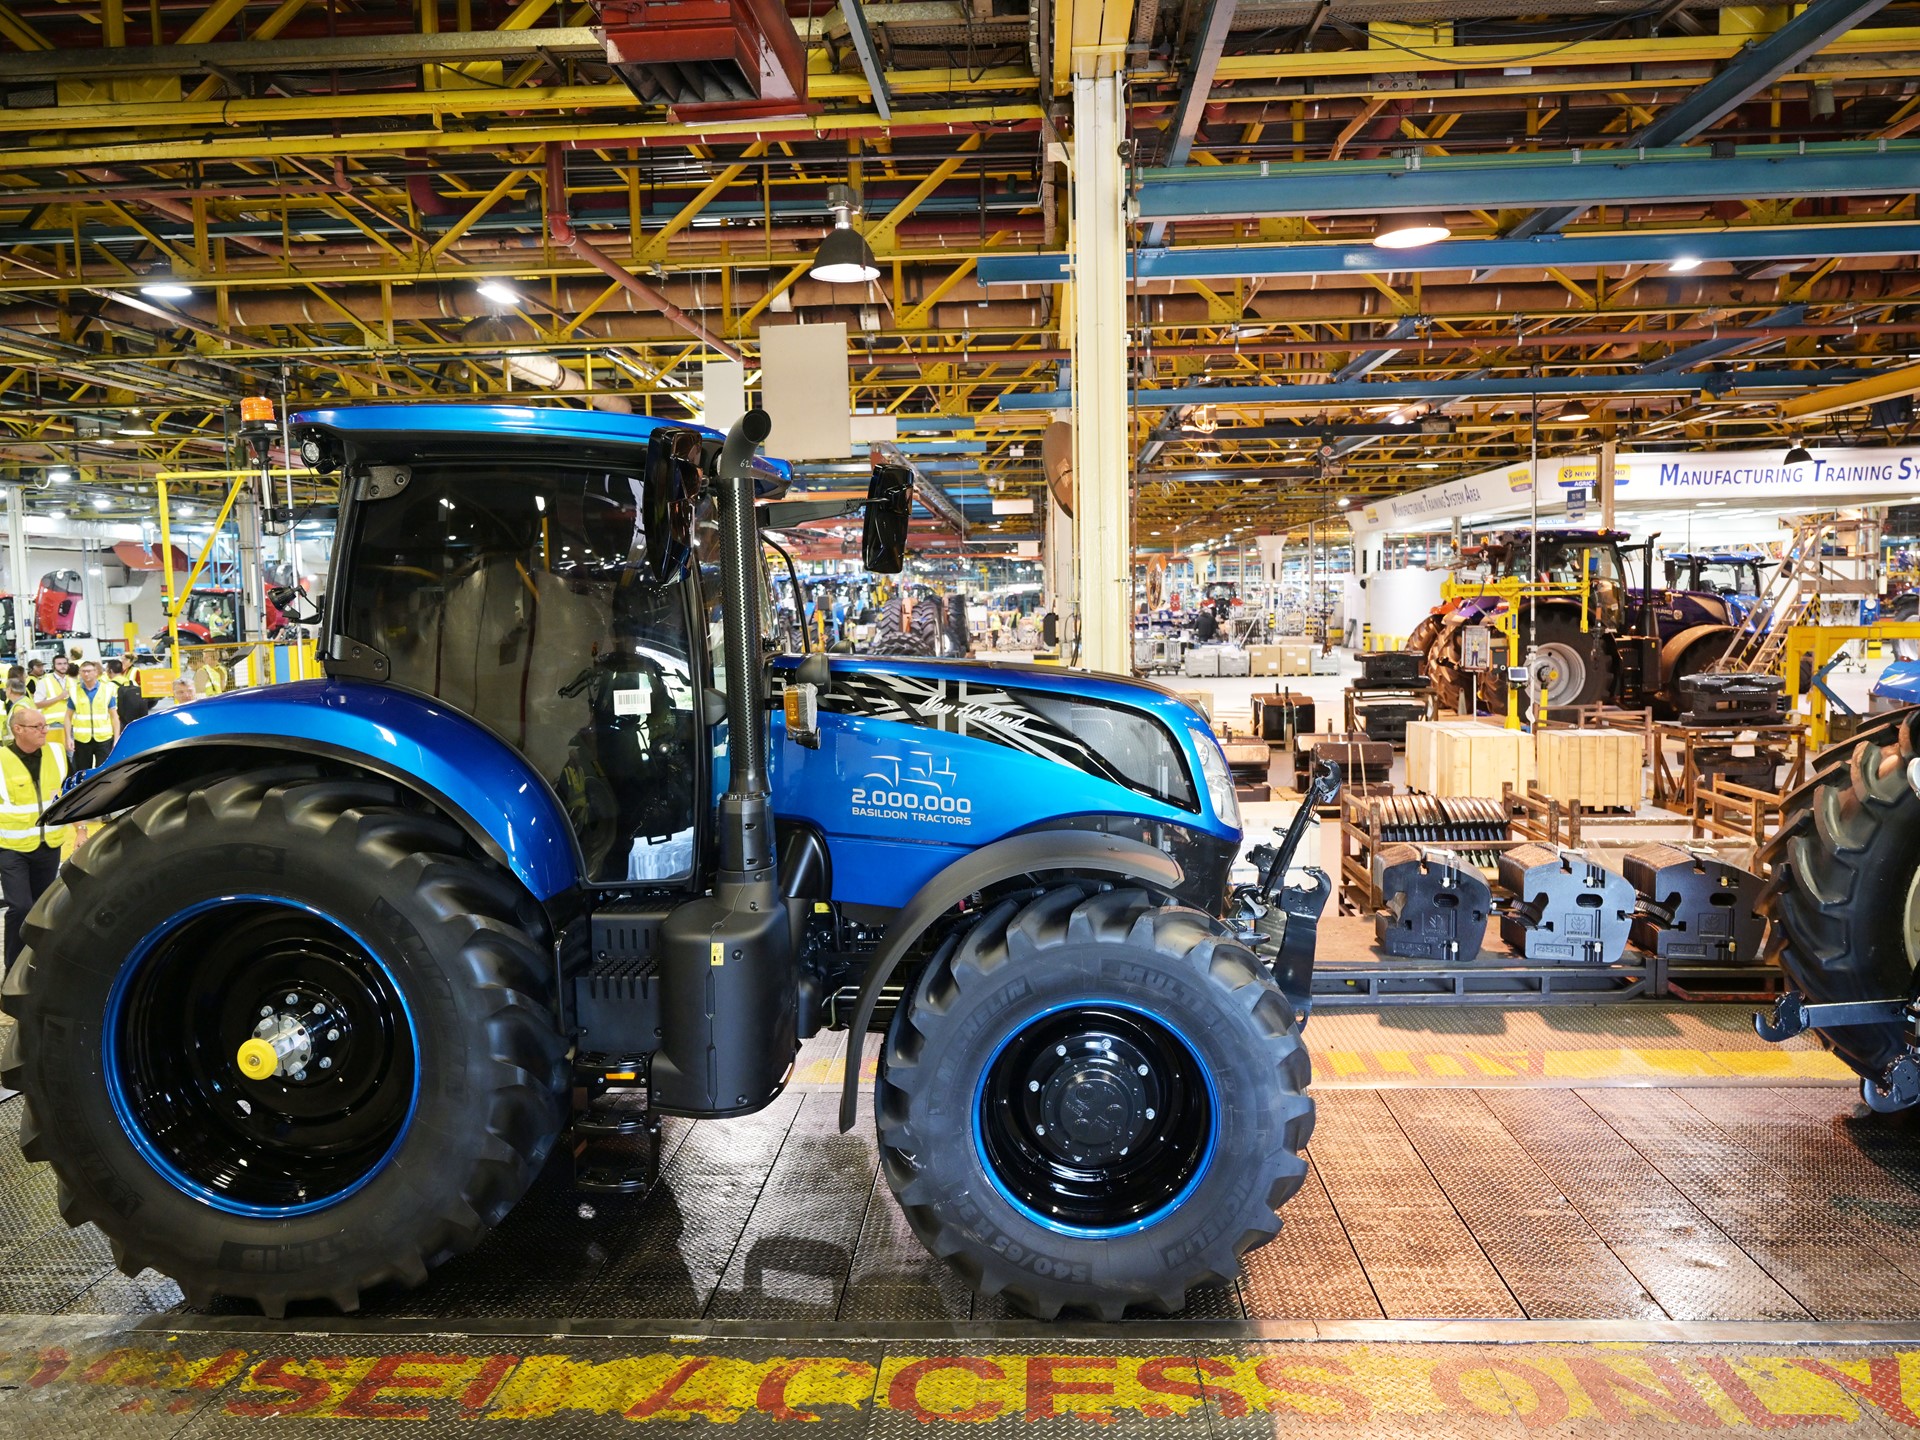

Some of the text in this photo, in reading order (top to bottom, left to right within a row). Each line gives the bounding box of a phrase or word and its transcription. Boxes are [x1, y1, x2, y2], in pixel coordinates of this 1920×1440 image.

[1660, 463, 1803, 486] MANUFACTURING
[1814, 459, 1893, 482] TRAINING
[1391, 500, 1426, 518] MANUFACTURING
[1423, 494, 1446, 513] TRAINING
[1444, 489, 1465, 508] SYSTEM
[1464, 484, 1482, 502] AREA
[917, 694, 1030, 729] New Holland
[851, 788, 971, 814] 2,000,000
[852, 807, 972, 826] BASILDON TRACTORS
[992, 1234, 1087, 1284] 540/65
[1430, 1356, 1920, 1430] ONLY
